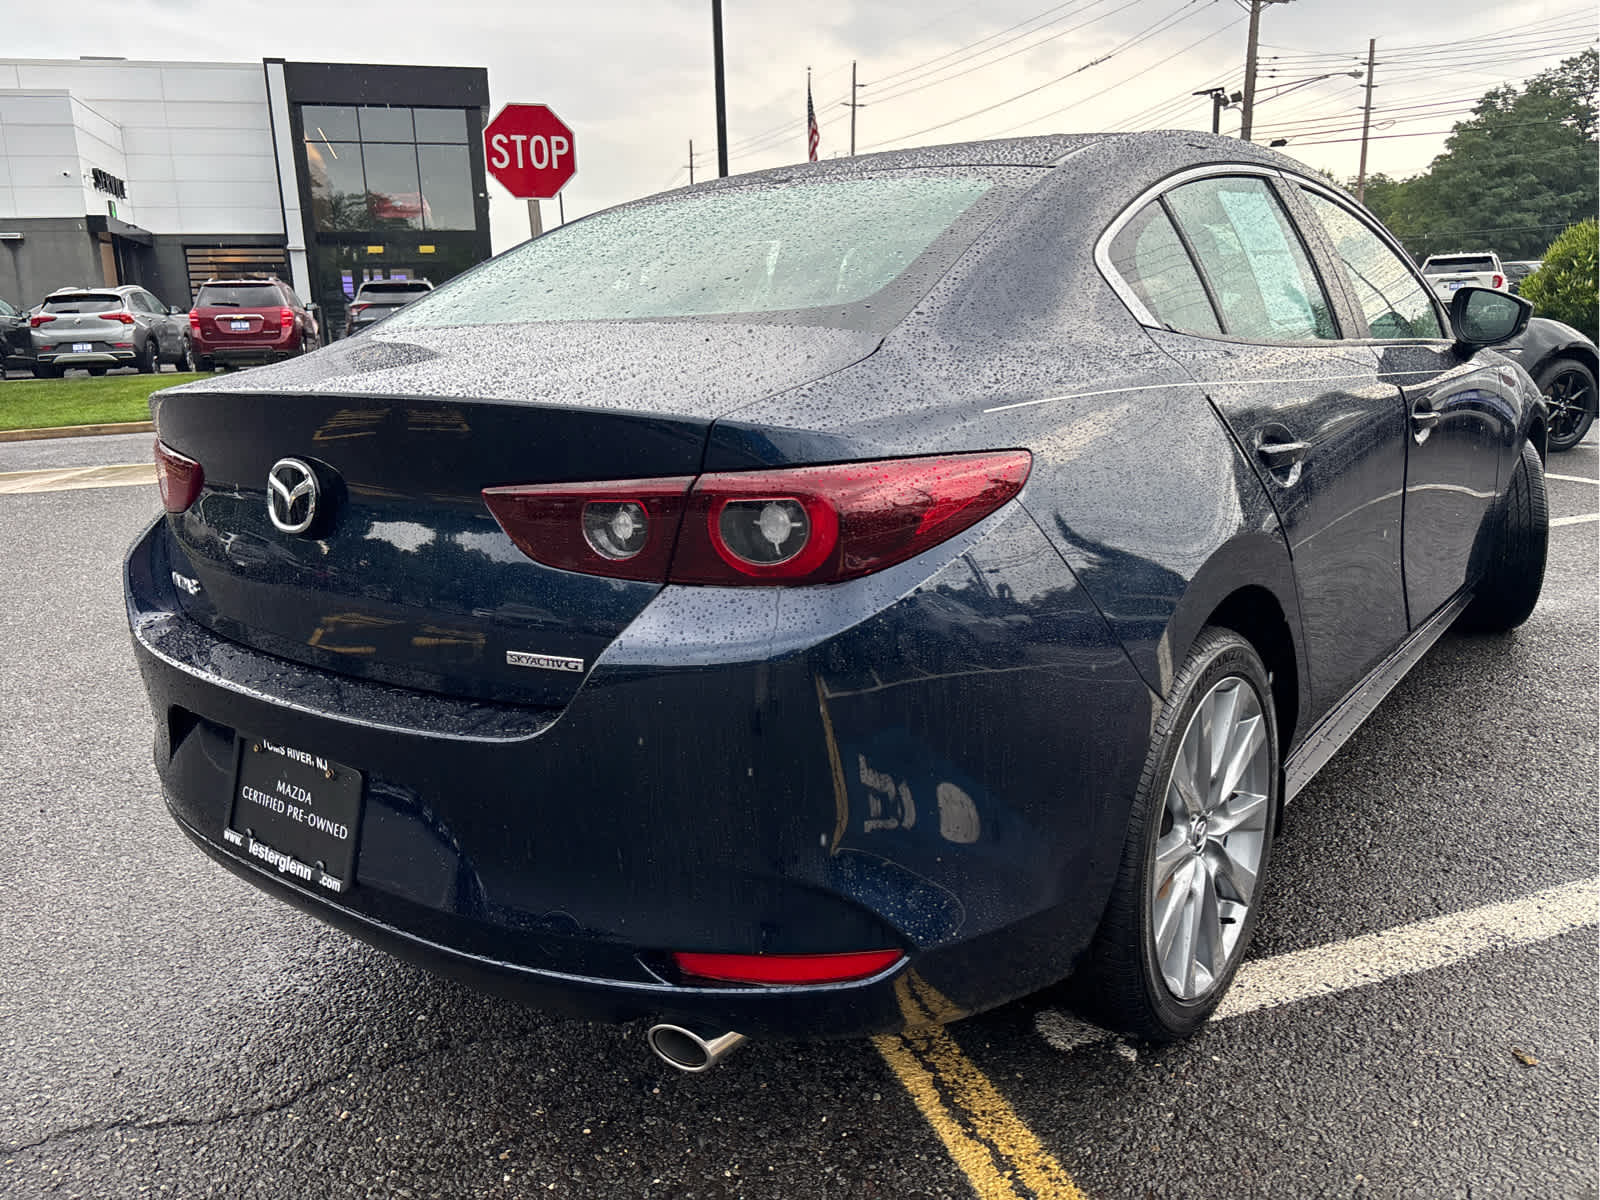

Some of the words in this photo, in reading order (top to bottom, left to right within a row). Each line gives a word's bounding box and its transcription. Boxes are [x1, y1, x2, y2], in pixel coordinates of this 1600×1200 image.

[491, 133, 569, 170] STOP
[286, 747, 315, 767] RIVER,
[316, 756, 328, 771] NJ
[276, 780, 312, 806] MAZDA
[242, 785, 285, 813] CERTIFIED
[286, 804, 348, 840] PRE-OWNED
